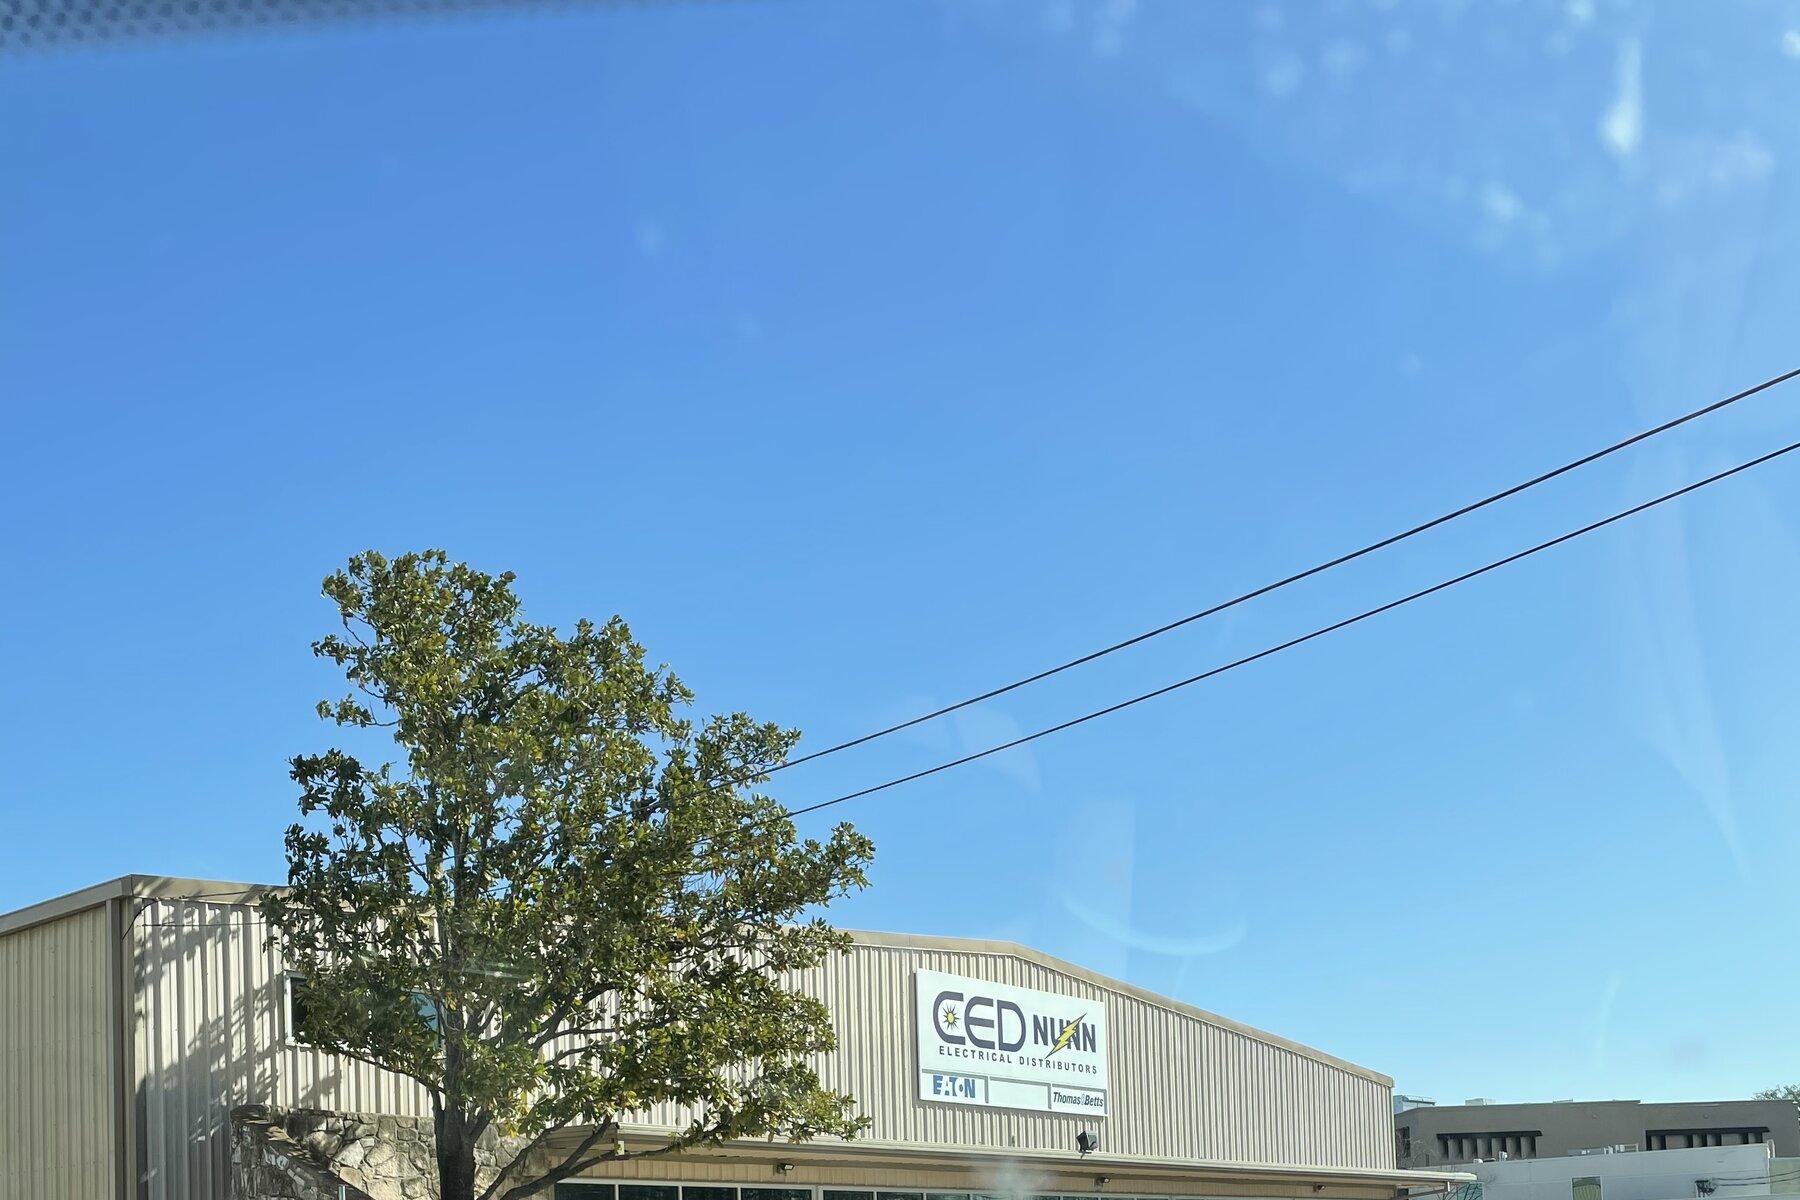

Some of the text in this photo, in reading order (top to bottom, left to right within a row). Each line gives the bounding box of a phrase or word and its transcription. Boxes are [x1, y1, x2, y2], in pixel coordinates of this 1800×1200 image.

[933, 990, 1096, 1053] CED NUNN
[939, 1045, 1098, 1075] ELECTRICAL DISTRIBUTORS
[933, 1075, 975, 1099] EATON
